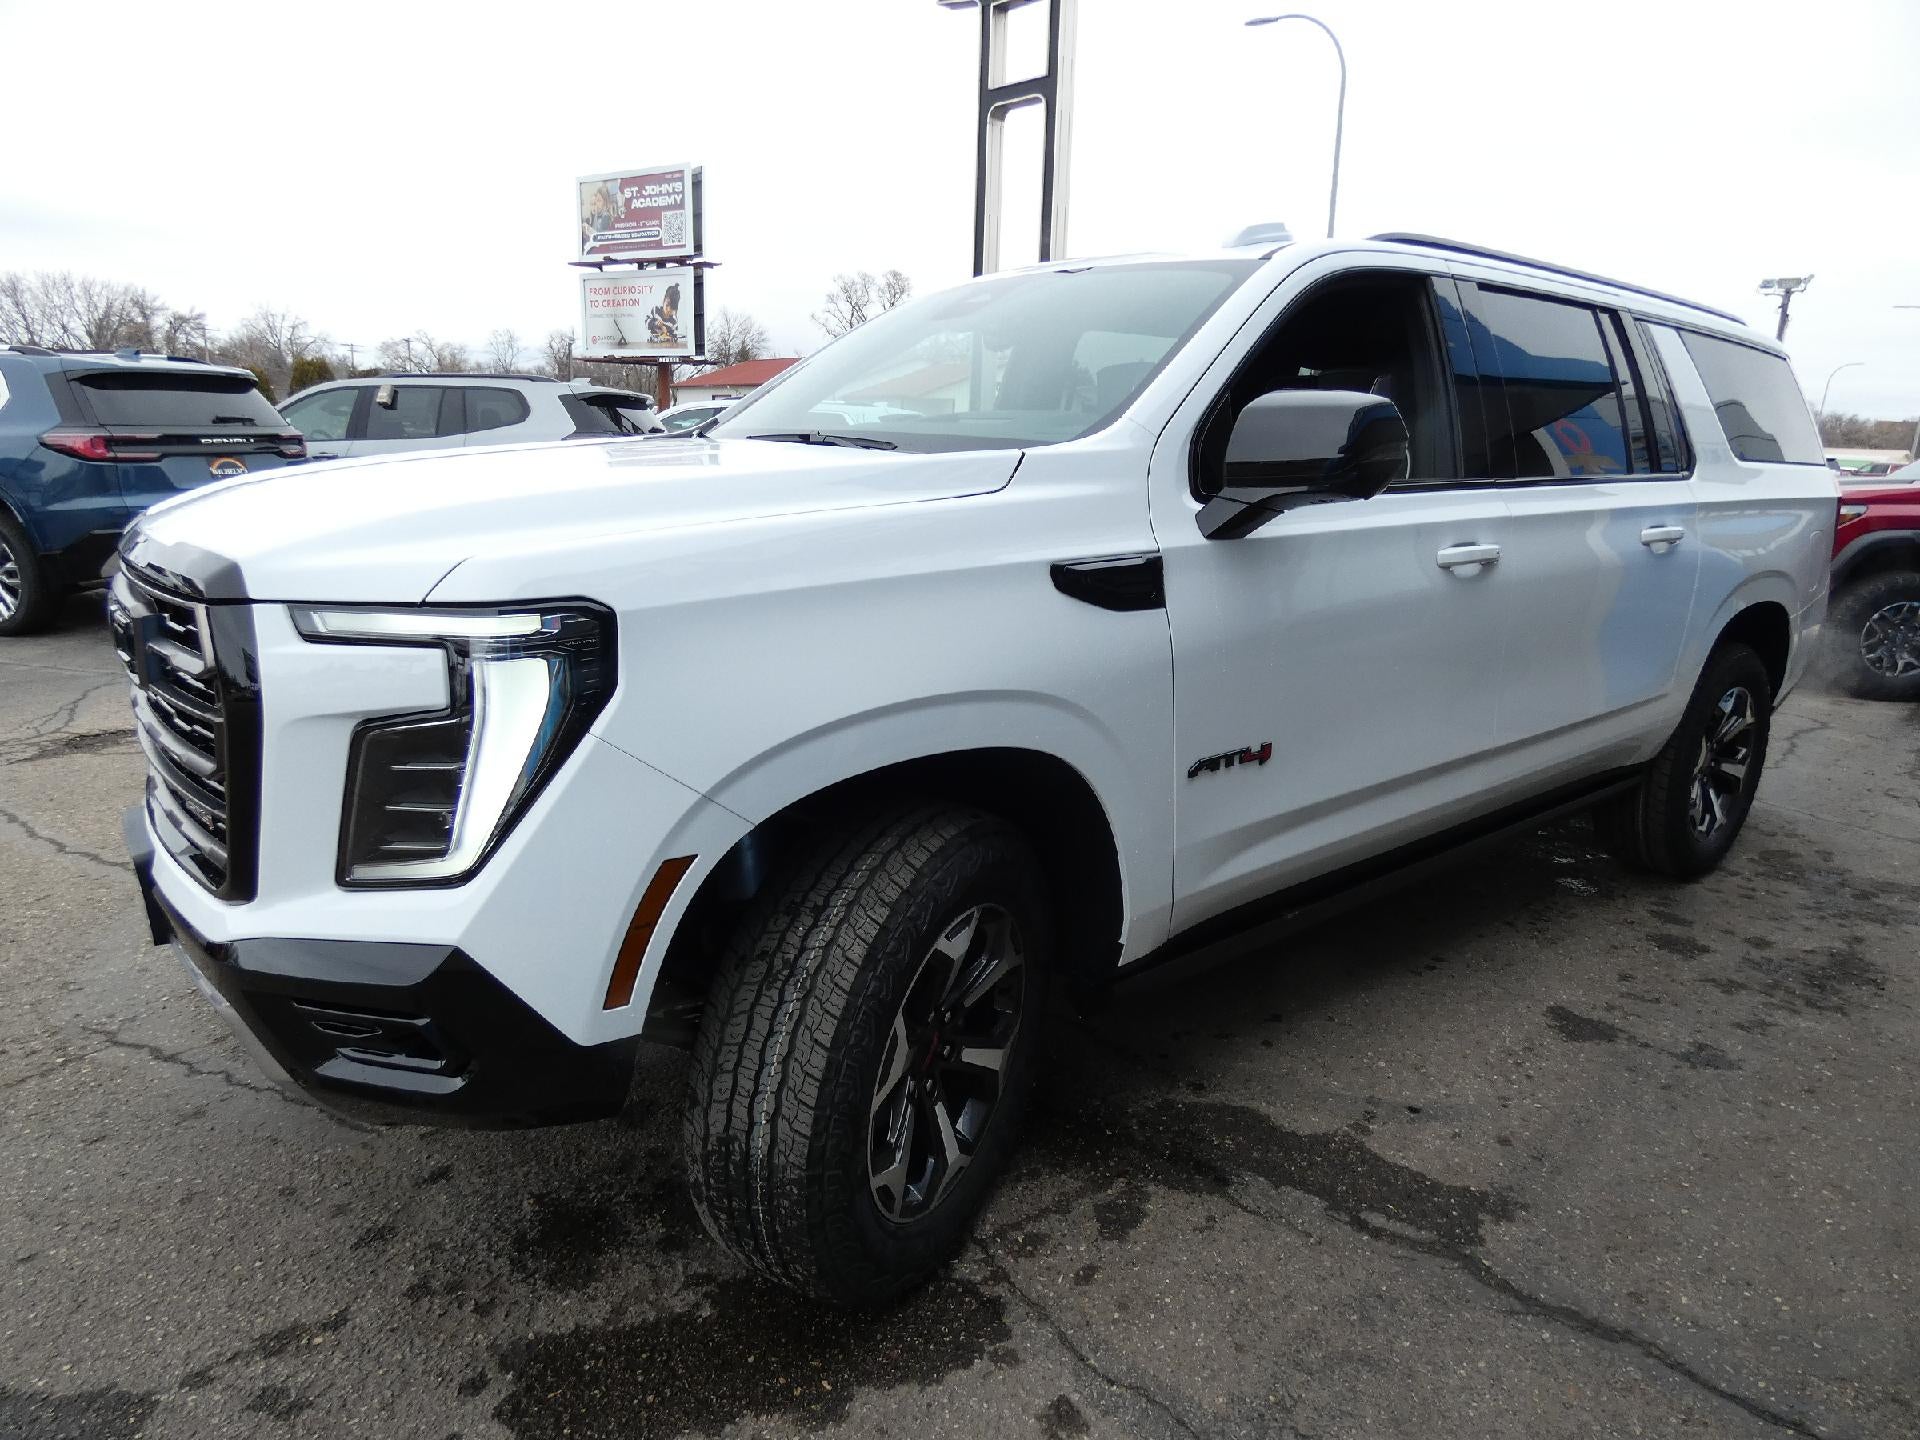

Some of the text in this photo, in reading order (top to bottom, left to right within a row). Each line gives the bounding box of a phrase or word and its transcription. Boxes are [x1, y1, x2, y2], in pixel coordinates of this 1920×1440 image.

[624, 182, 683, 198] ST. JOHN'S
[631, 195, 683, 209] ACADEMY
[589, 285, 654, 296] FROM CURIOSITY
[589, 299, 640, 308] TO CREATION
[1187, 741, 1272, 778] AT4
